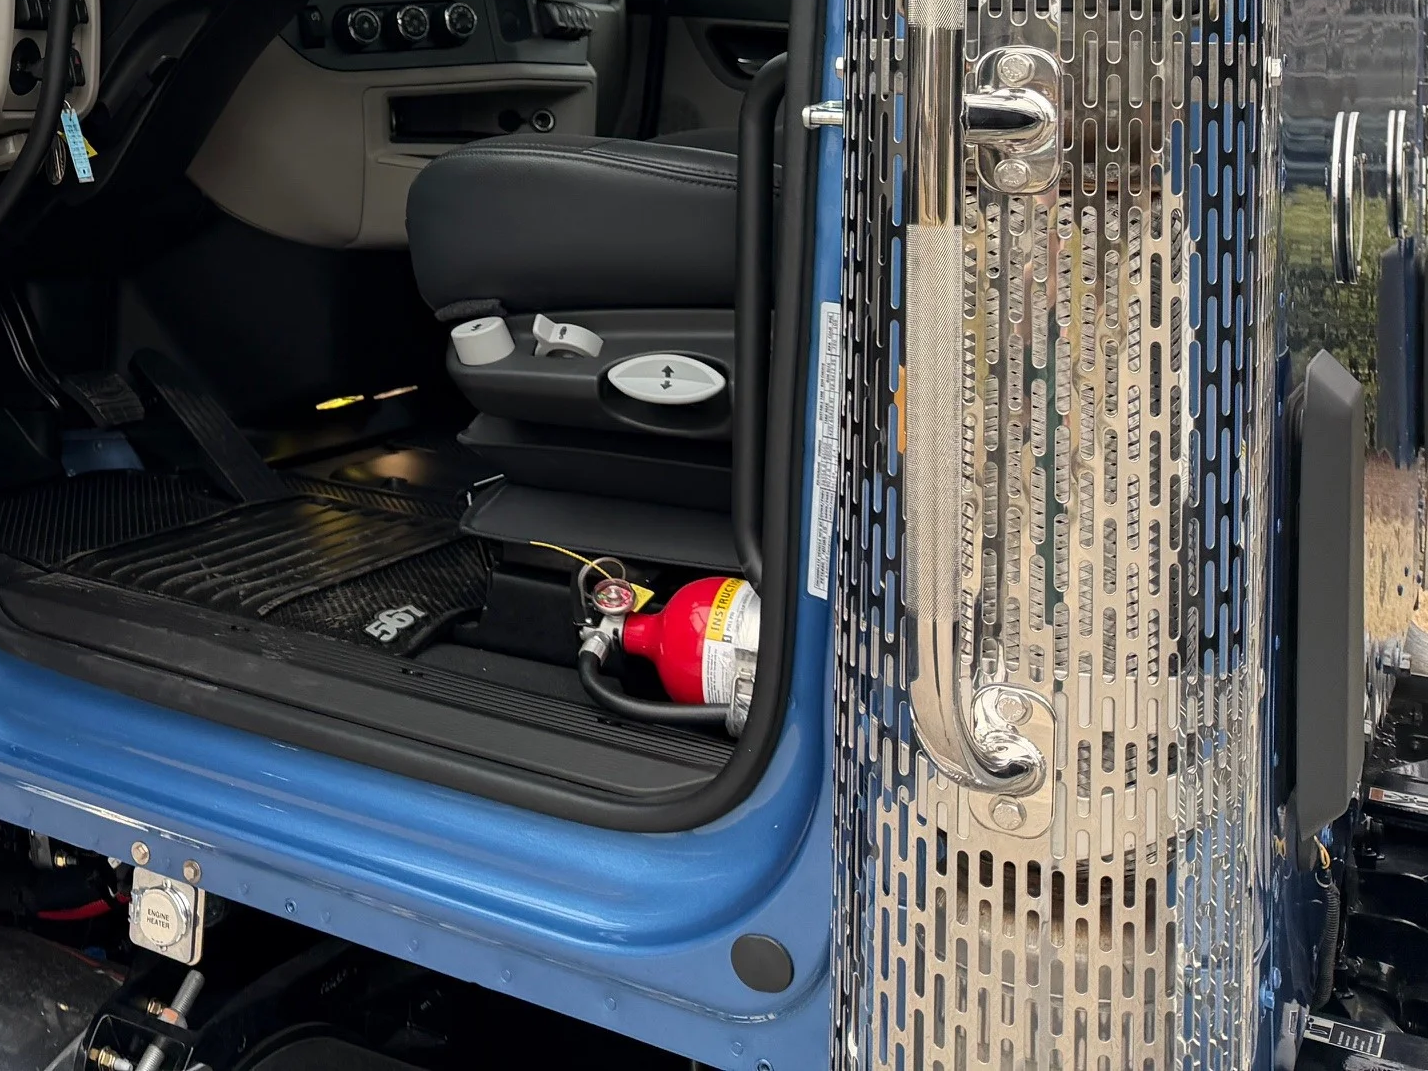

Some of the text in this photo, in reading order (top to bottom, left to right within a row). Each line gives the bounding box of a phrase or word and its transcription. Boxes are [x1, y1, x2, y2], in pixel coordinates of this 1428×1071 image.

[365, 605, 426, 642] 567
[148, 908, 169, 921] ENGINE
[147, 917, 170, 929] HEATER
